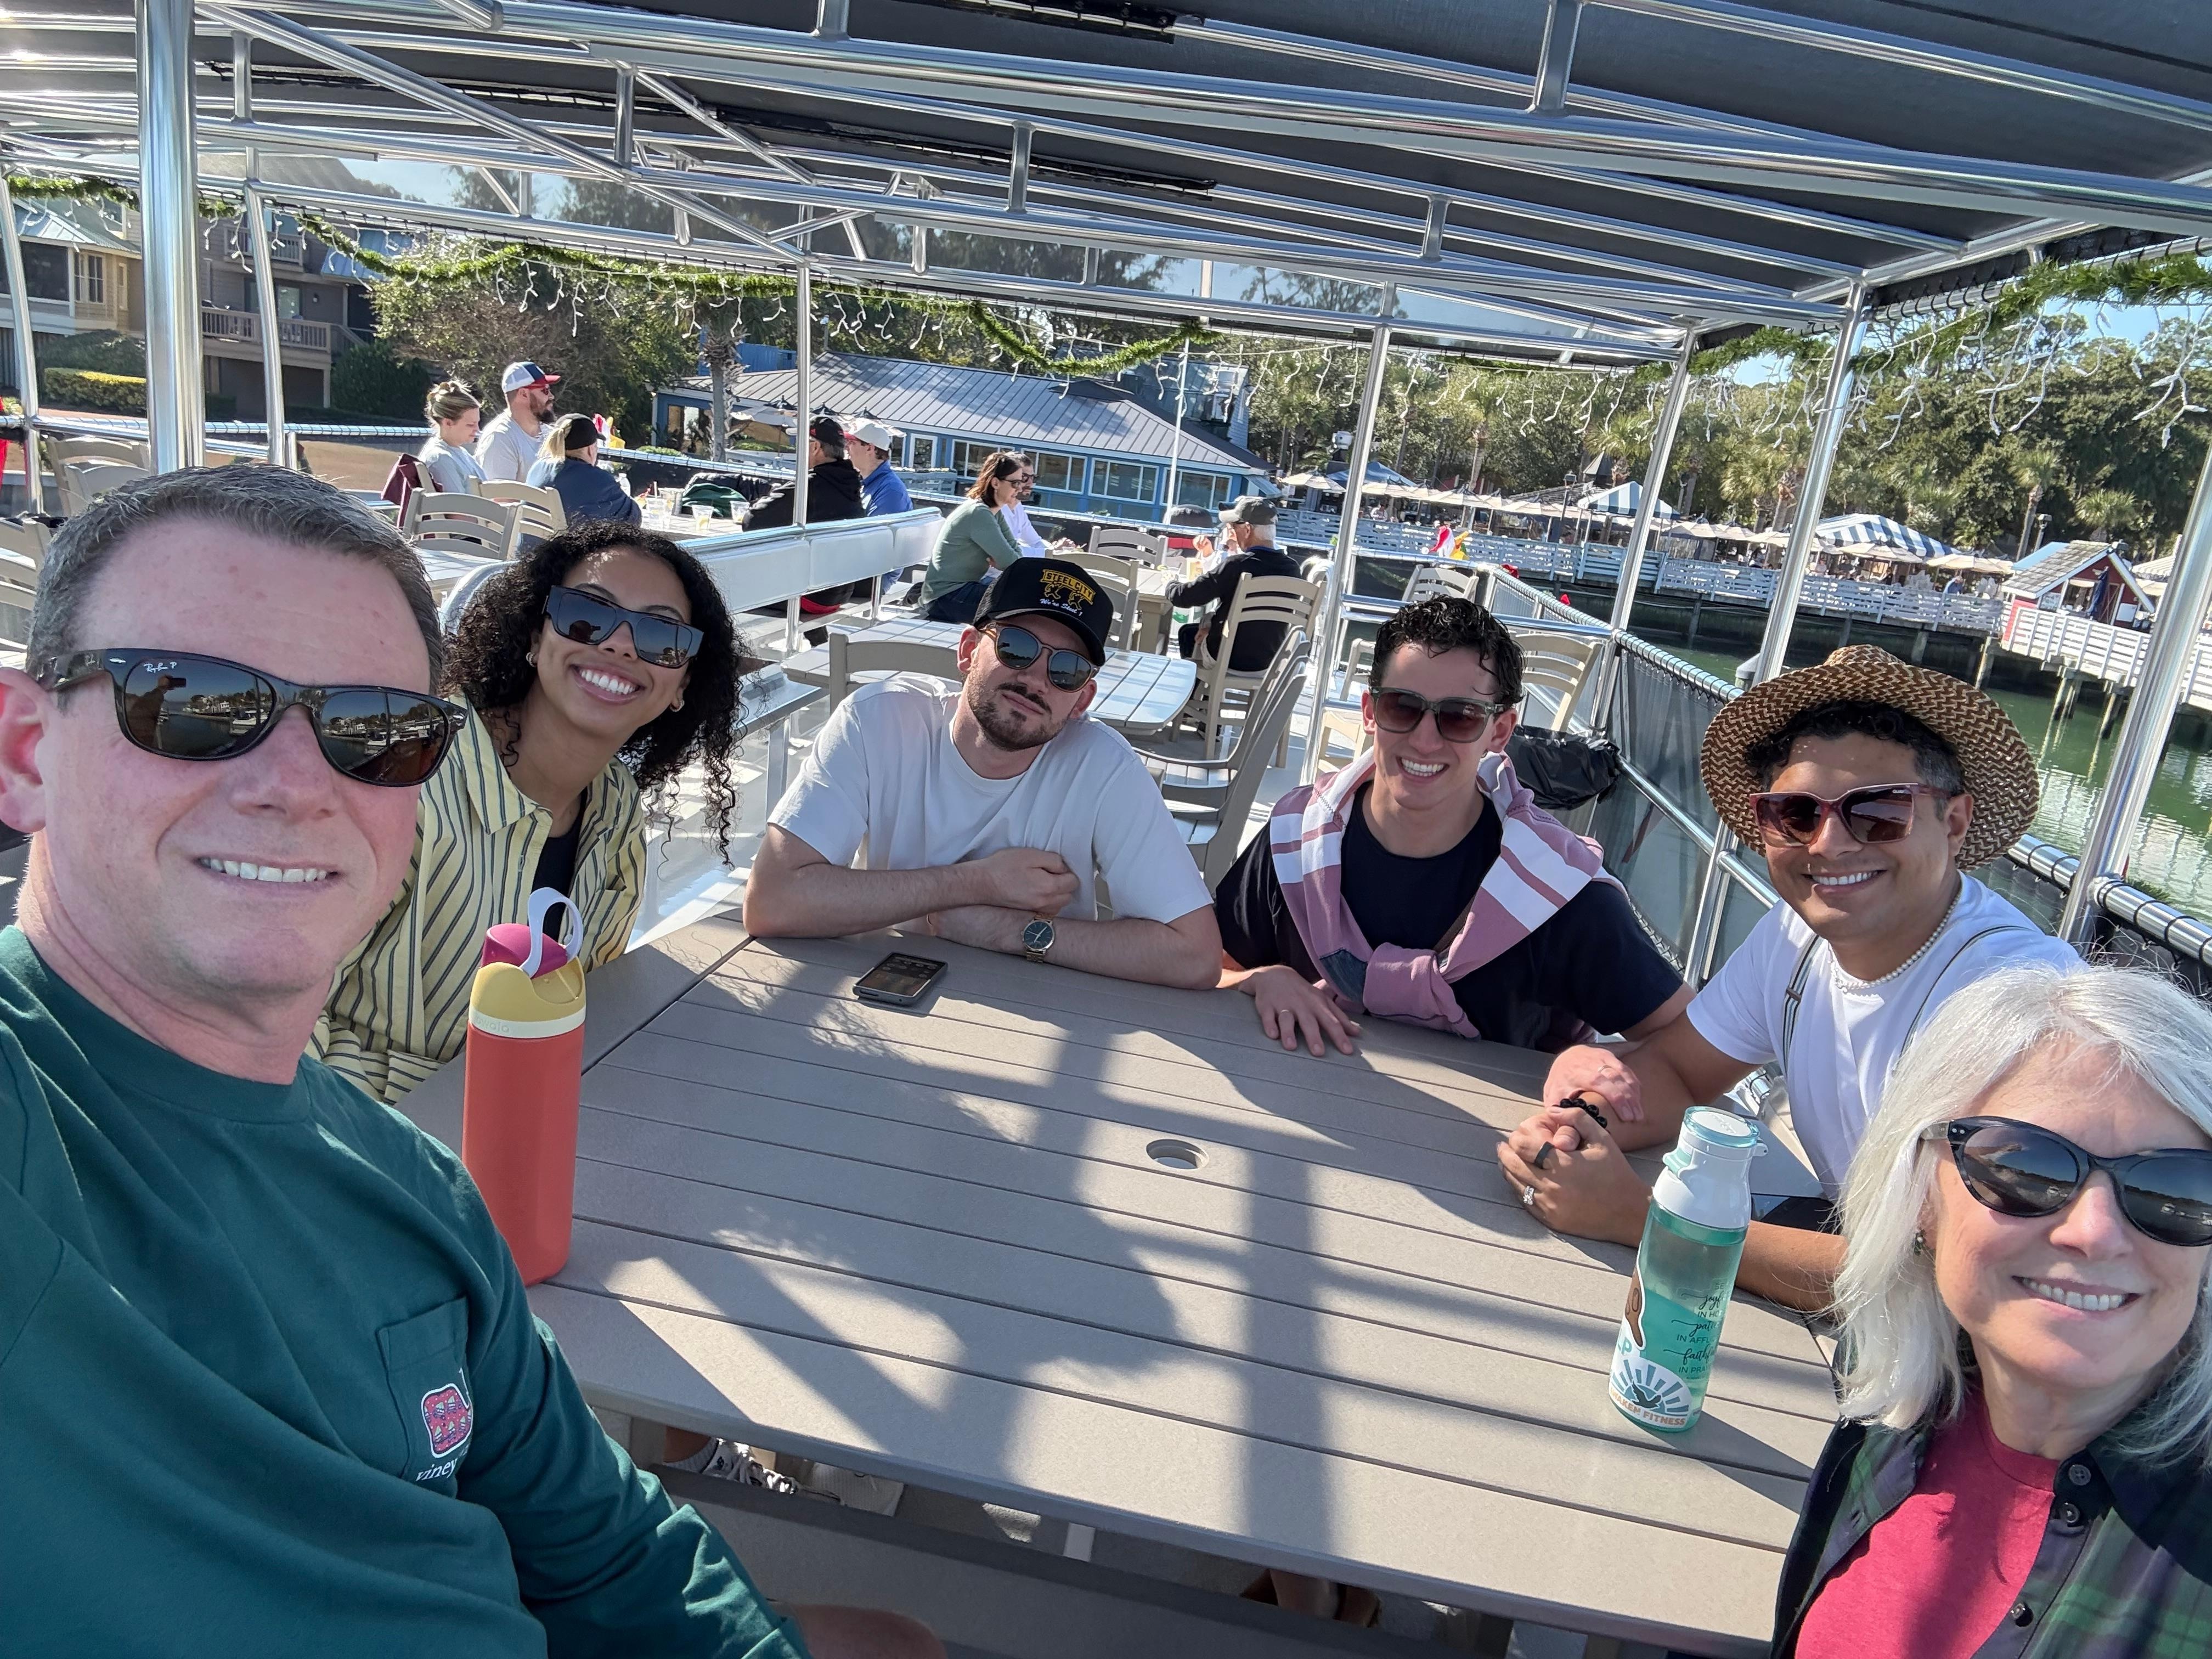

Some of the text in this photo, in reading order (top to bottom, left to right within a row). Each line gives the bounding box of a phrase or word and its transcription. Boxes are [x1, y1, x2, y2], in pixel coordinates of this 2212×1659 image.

[1046, 572, 1093, 597] STEEL CITY
[1643, 1410, 1686, 1425] FITNESS
